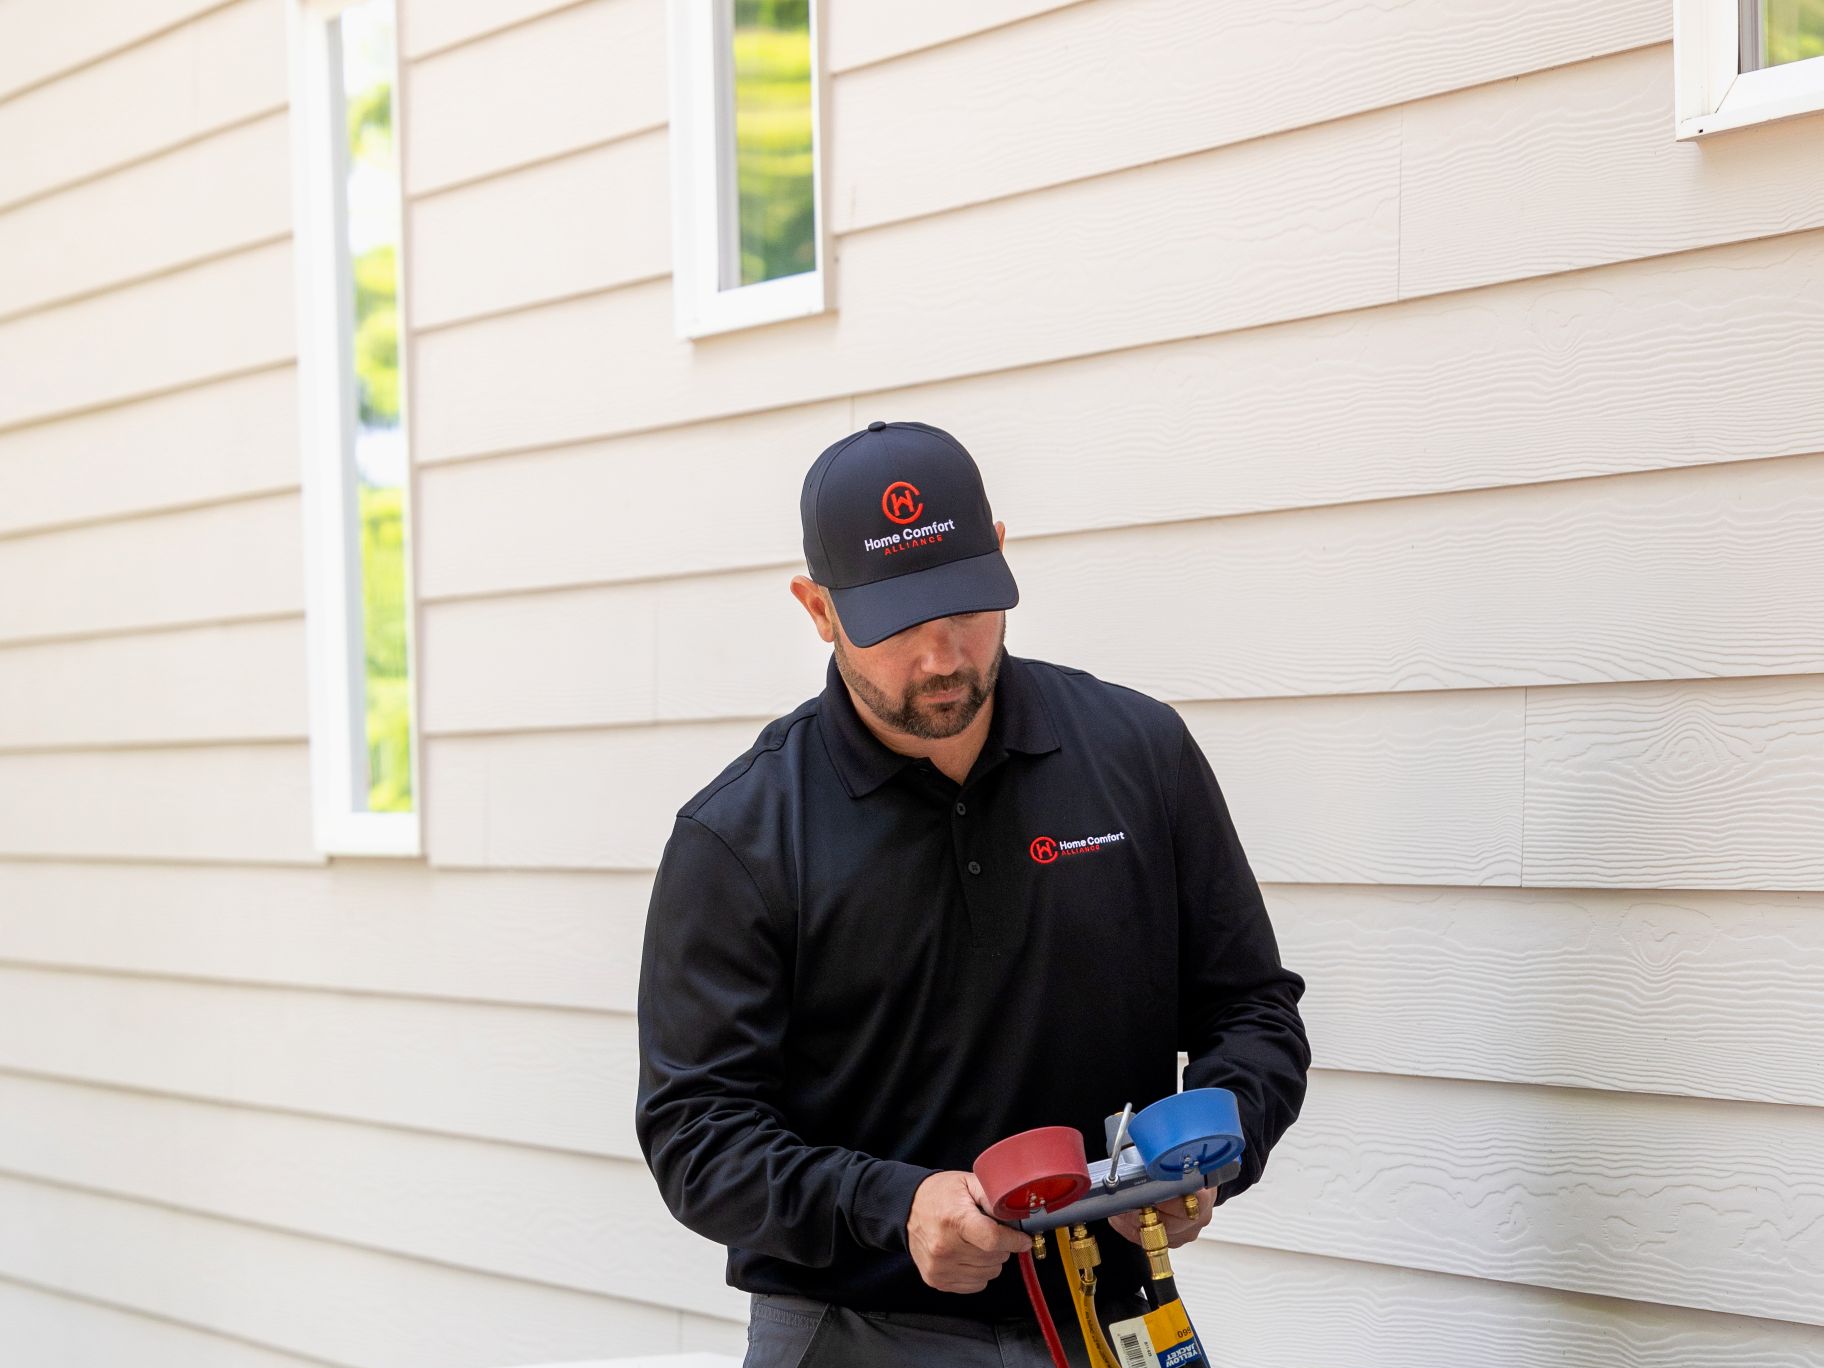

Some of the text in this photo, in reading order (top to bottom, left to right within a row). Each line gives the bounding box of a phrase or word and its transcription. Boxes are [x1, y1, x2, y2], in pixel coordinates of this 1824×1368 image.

[864, 519, 955, 551] Home Comfort
[884, 534, 943, 555] ALLIANCE
[1059, 831, 1125, 851] Home Comfort
[1165, 1348, 1198, 1368] YELLOW
[1166, 1342, 1195, 1360] JACKET
